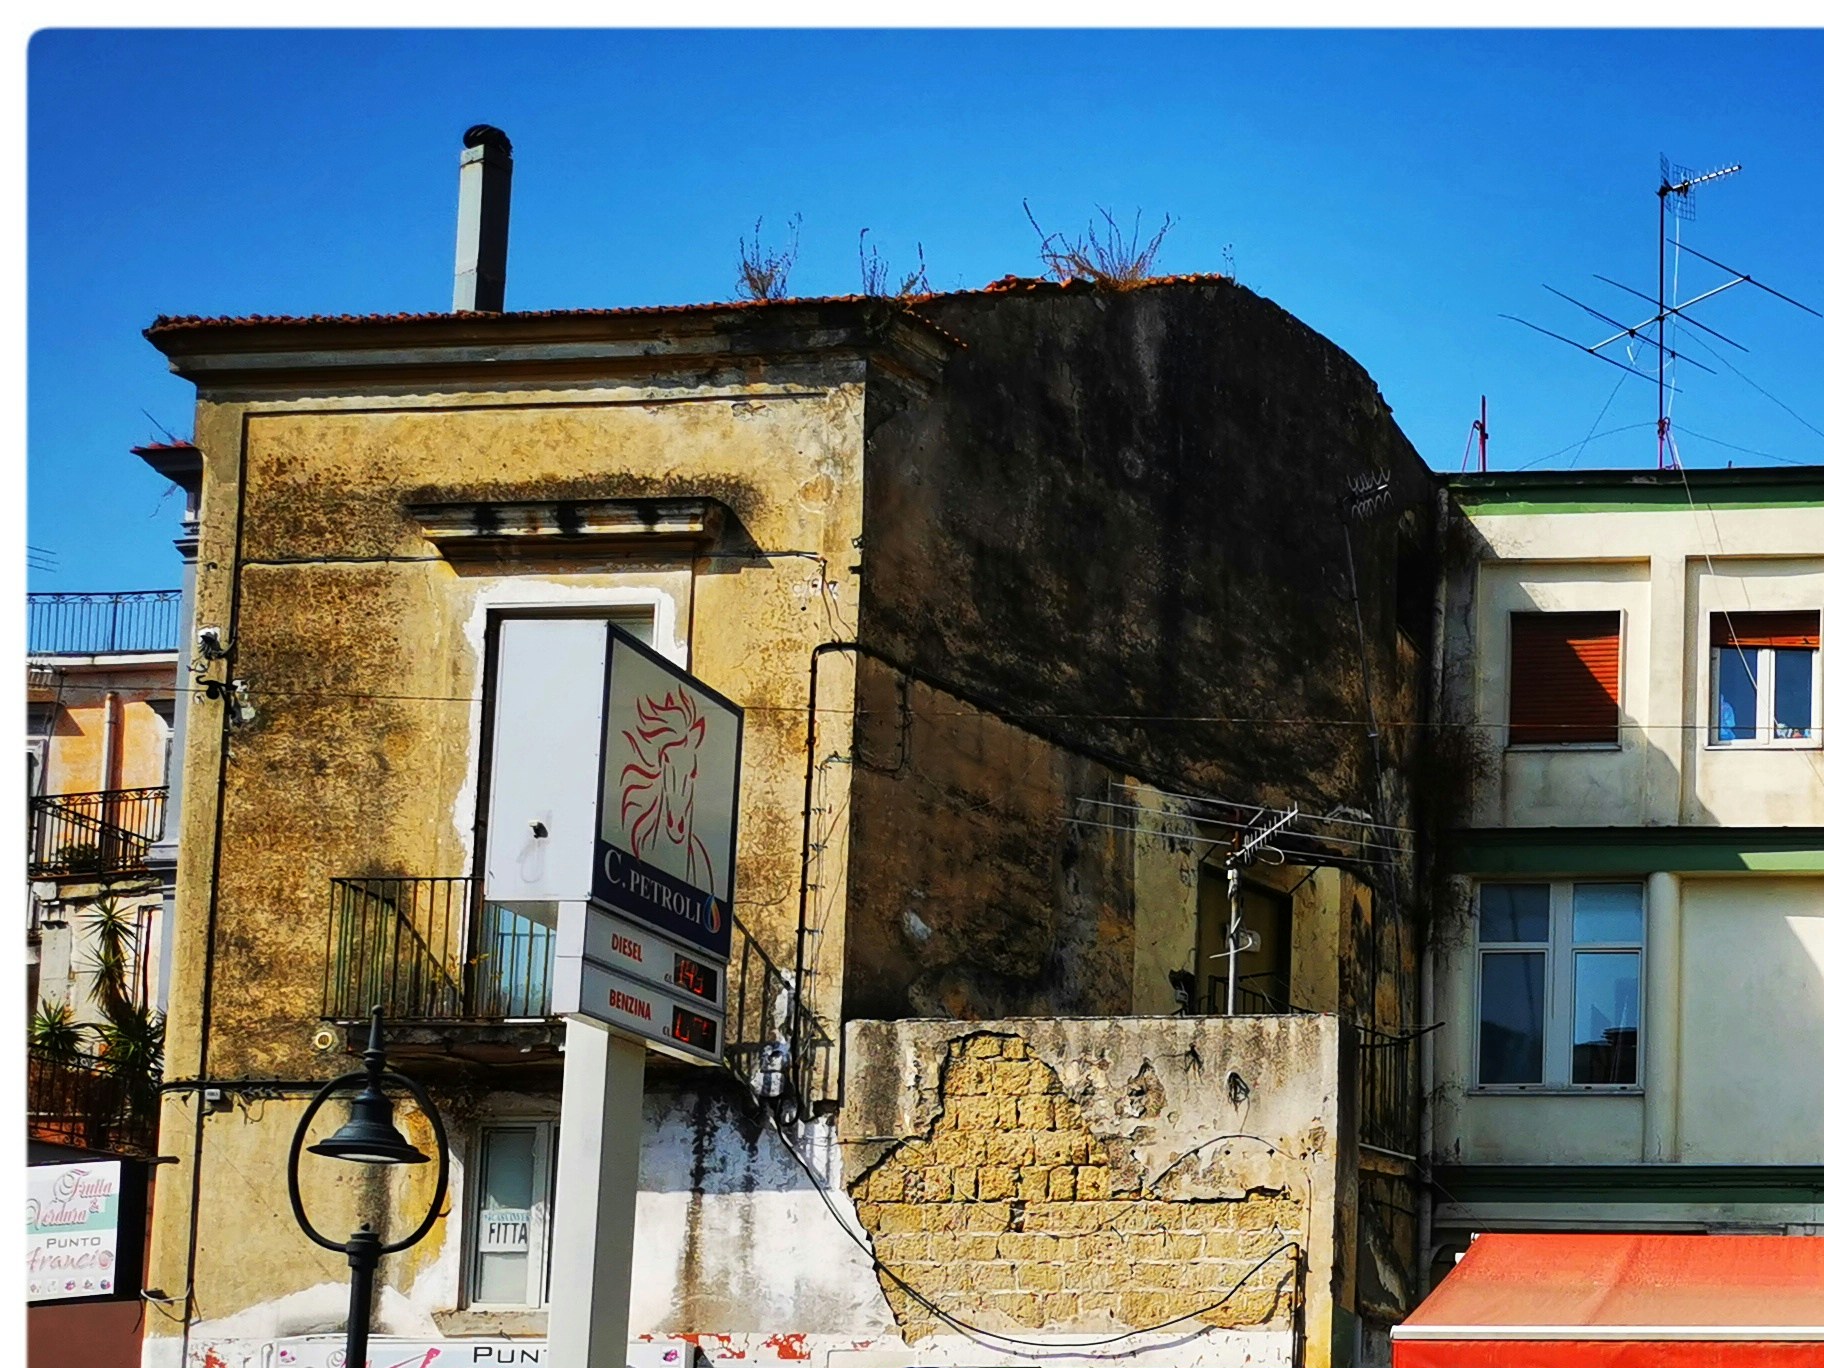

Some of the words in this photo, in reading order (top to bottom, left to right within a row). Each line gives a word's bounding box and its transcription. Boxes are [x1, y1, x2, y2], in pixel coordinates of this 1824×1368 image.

[611, 933, 643, 962] DIESEL
[609, 988, 652, 1020] BENZINA
[488, 1222, 528, 1244] FITTA
[473, 1346, 547, 1363] PUN
